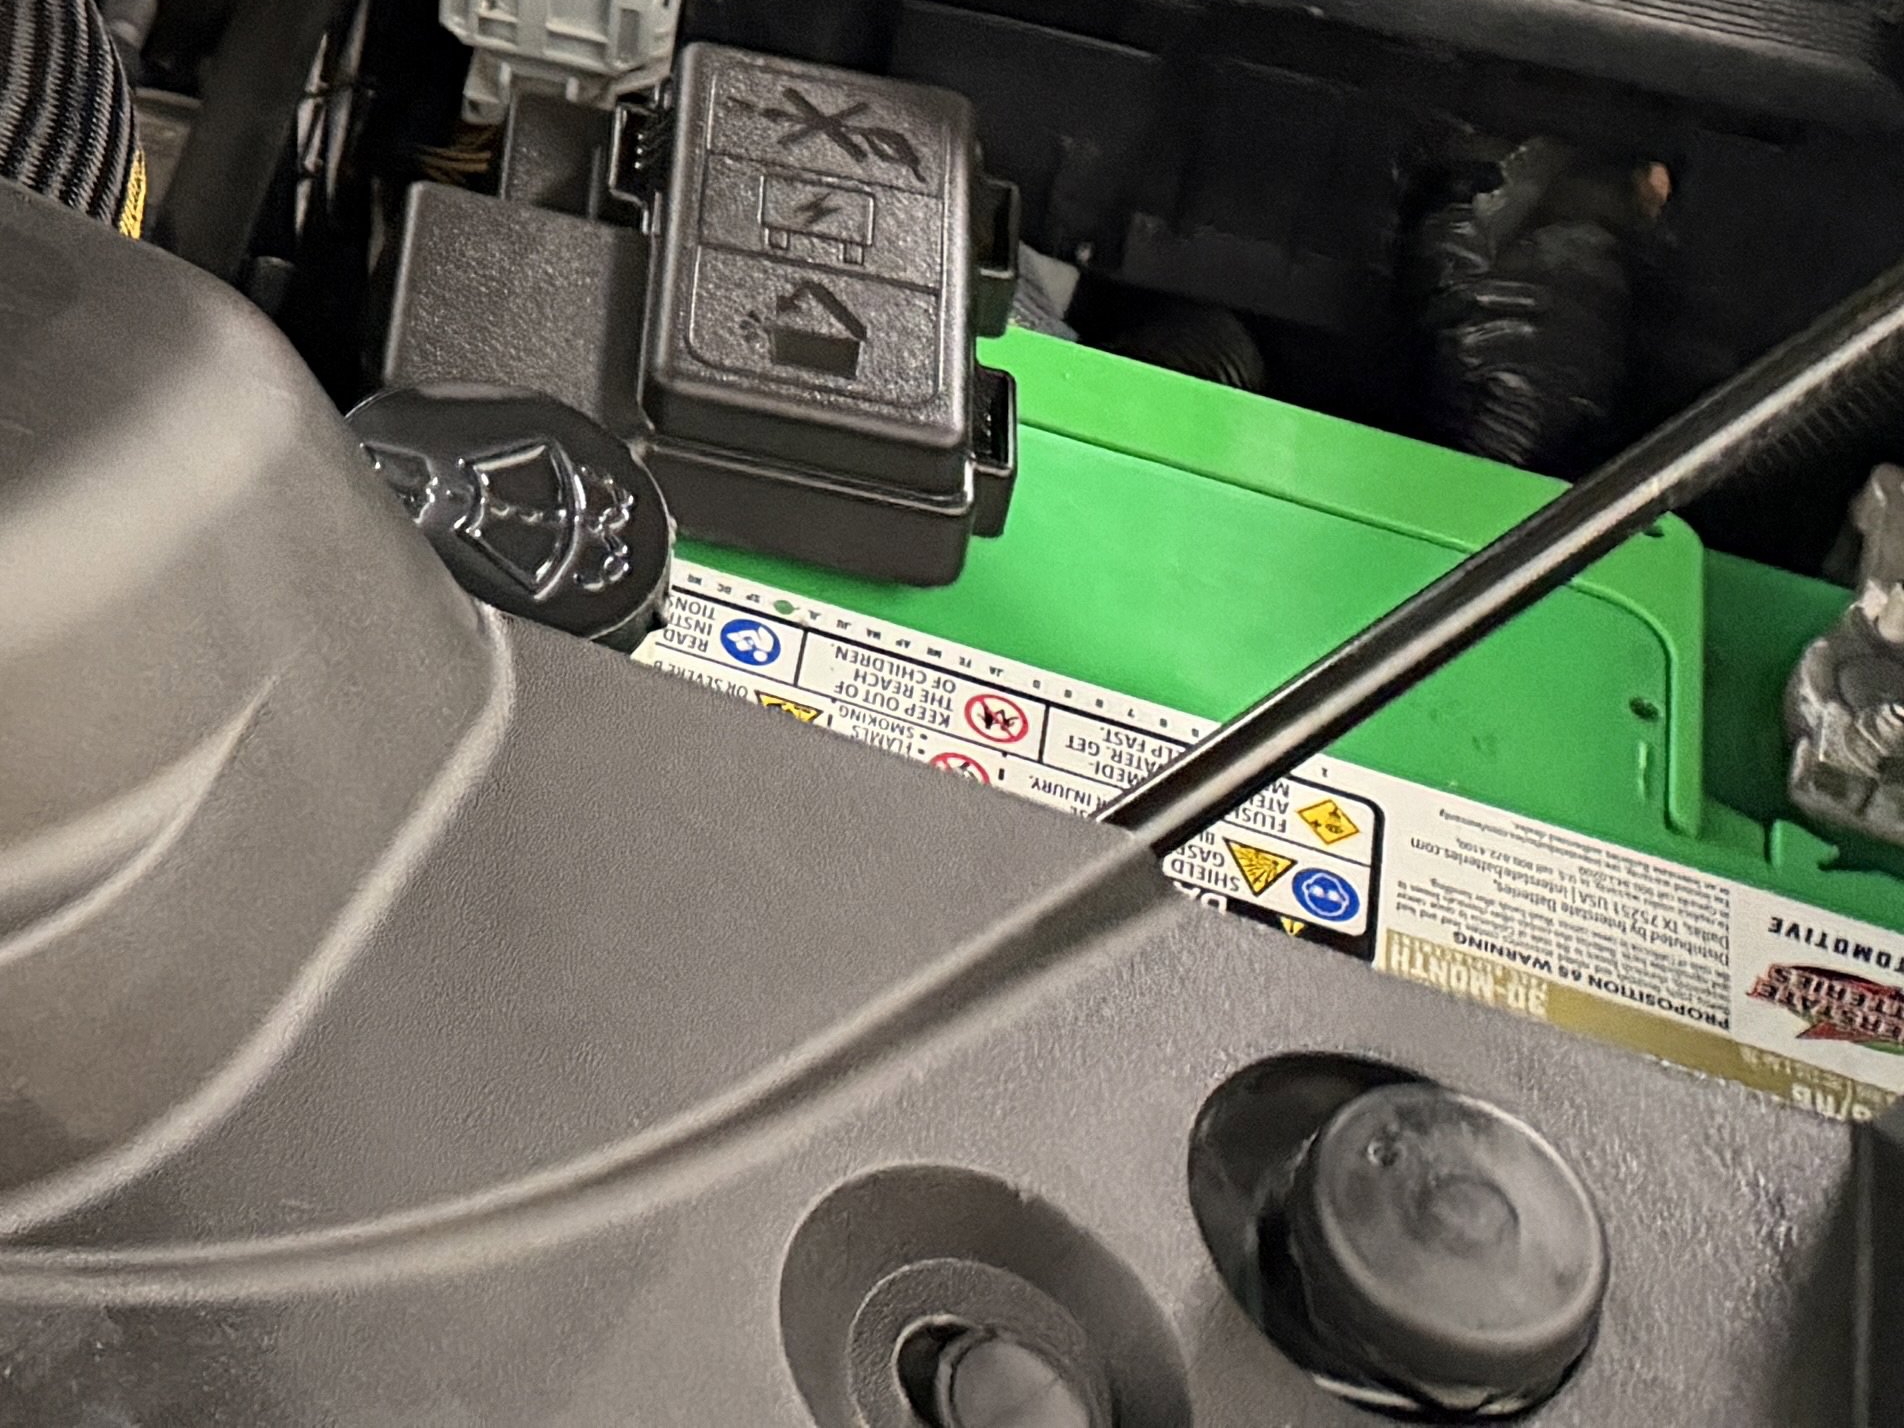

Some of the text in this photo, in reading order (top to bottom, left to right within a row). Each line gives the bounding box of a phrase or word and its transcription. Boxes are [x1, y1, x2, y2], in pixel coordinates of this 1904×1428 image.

[662, 626, 708, 652] READ
[831, 644, 956, 693] OF CHILDREN.
[834, 680, 950, 728] KEEP OUT OF
[853, 668, 952, 711] THE REACH
[838, 704, 913, 738] SMOKING
[1065, 735, 1100, 756] GET
[1100, 727, 1145, 752] FAST.
[1029, 775, 1091, 806] INJURY.
[1170, 858, 1239, 891] SHIELD
[1578, 890, 1608, 911] USA
[1629, 919, 1646, 941] by
[1452, 931, 1551, 973] WARNING
[1650, 930, 1729, 967] Distributed
[1588, 974, 1729, 1030] PROPOSITION
